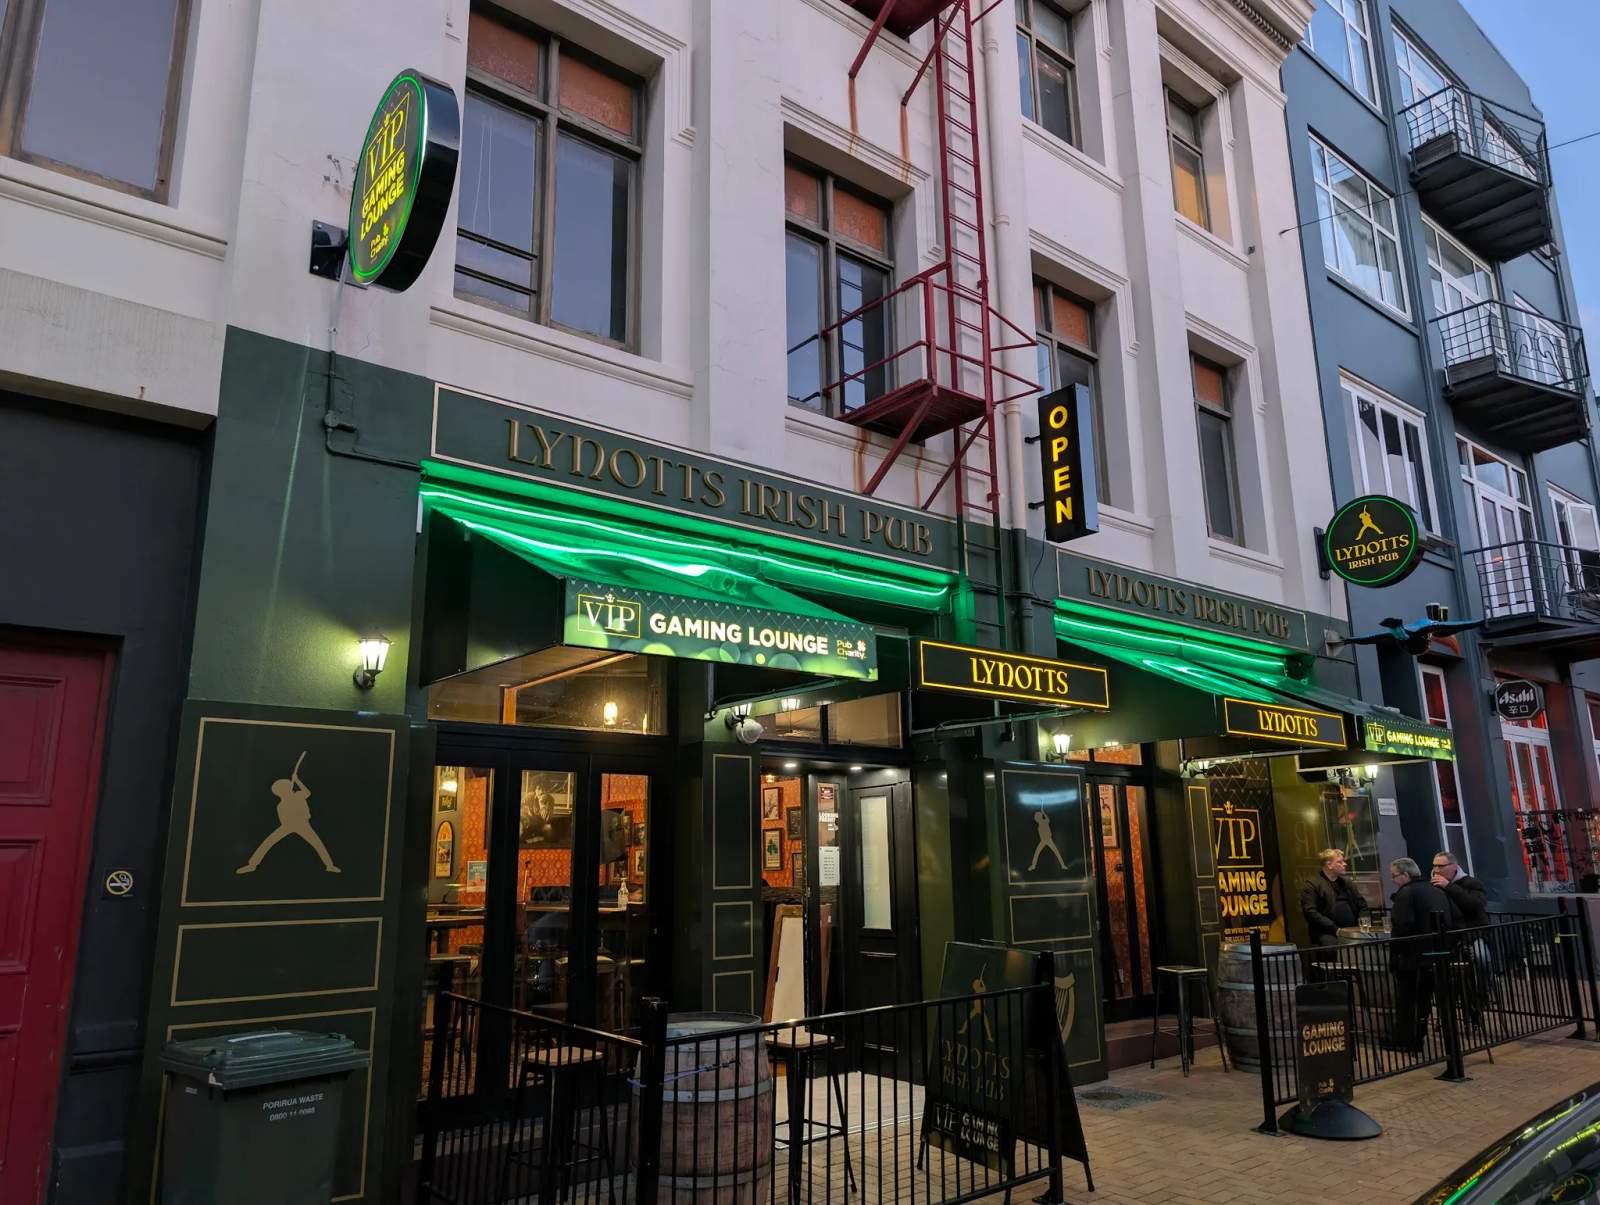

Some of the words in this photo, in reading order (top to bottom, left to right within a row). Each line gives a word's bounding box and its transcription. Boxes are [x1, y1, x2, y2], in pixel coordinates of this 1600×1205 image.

[370, 110, 404, 181] VIP
[362, 151, 405, 218] GAMING
[361, 173, 405, 240] LOUNGE
[1049, 405, 1073, 524] OPEN
[505, 416, 727, 508] LYNOTTS
[739, 479, 848, 537] IRISH
[859, 509, 934, 556] PUB
[1335, 534, 1410, 561] LYNOTTS
[1348, 557, 1376, 570] IRISH
[1378, 552, 1399, 563] PUB
[1086, 567, 1189, 616] LYNOTTS
[1191, 593, 1248, 631] IRISH
[1252, 608, 1291, 640] PUB
[582, 600, 636, 632] VIP
[649, 613, 742, 643] GAMING
[749, 626, 829, 655] LOUNGE
[836, 640, 852, 649] Pub
[969, 657, 1069, 694] LYNOTTS
[1499, 689, 1536, 704] Asahi
[1509, 705, 1529, 714] 辛口
[1257, 709, 1318, 737] LYNOTTS
[1368, 726, 1385, 743] VIP
[1386, 730, 1414, 745] GAMING
[1414, 734, 1440, 749] LOUNGE
[1218, 871, 1267, 893] AMING
[1220, 894, 1269, 917] OUNGE
[1302, 1021, 1345, 1040] GAMING
[1303, 1036, 1346, 1056] LOUNGE
[262, 1098, 297, 1110] PORIRUA
[299, 1093, 324, 1103] WASTE
